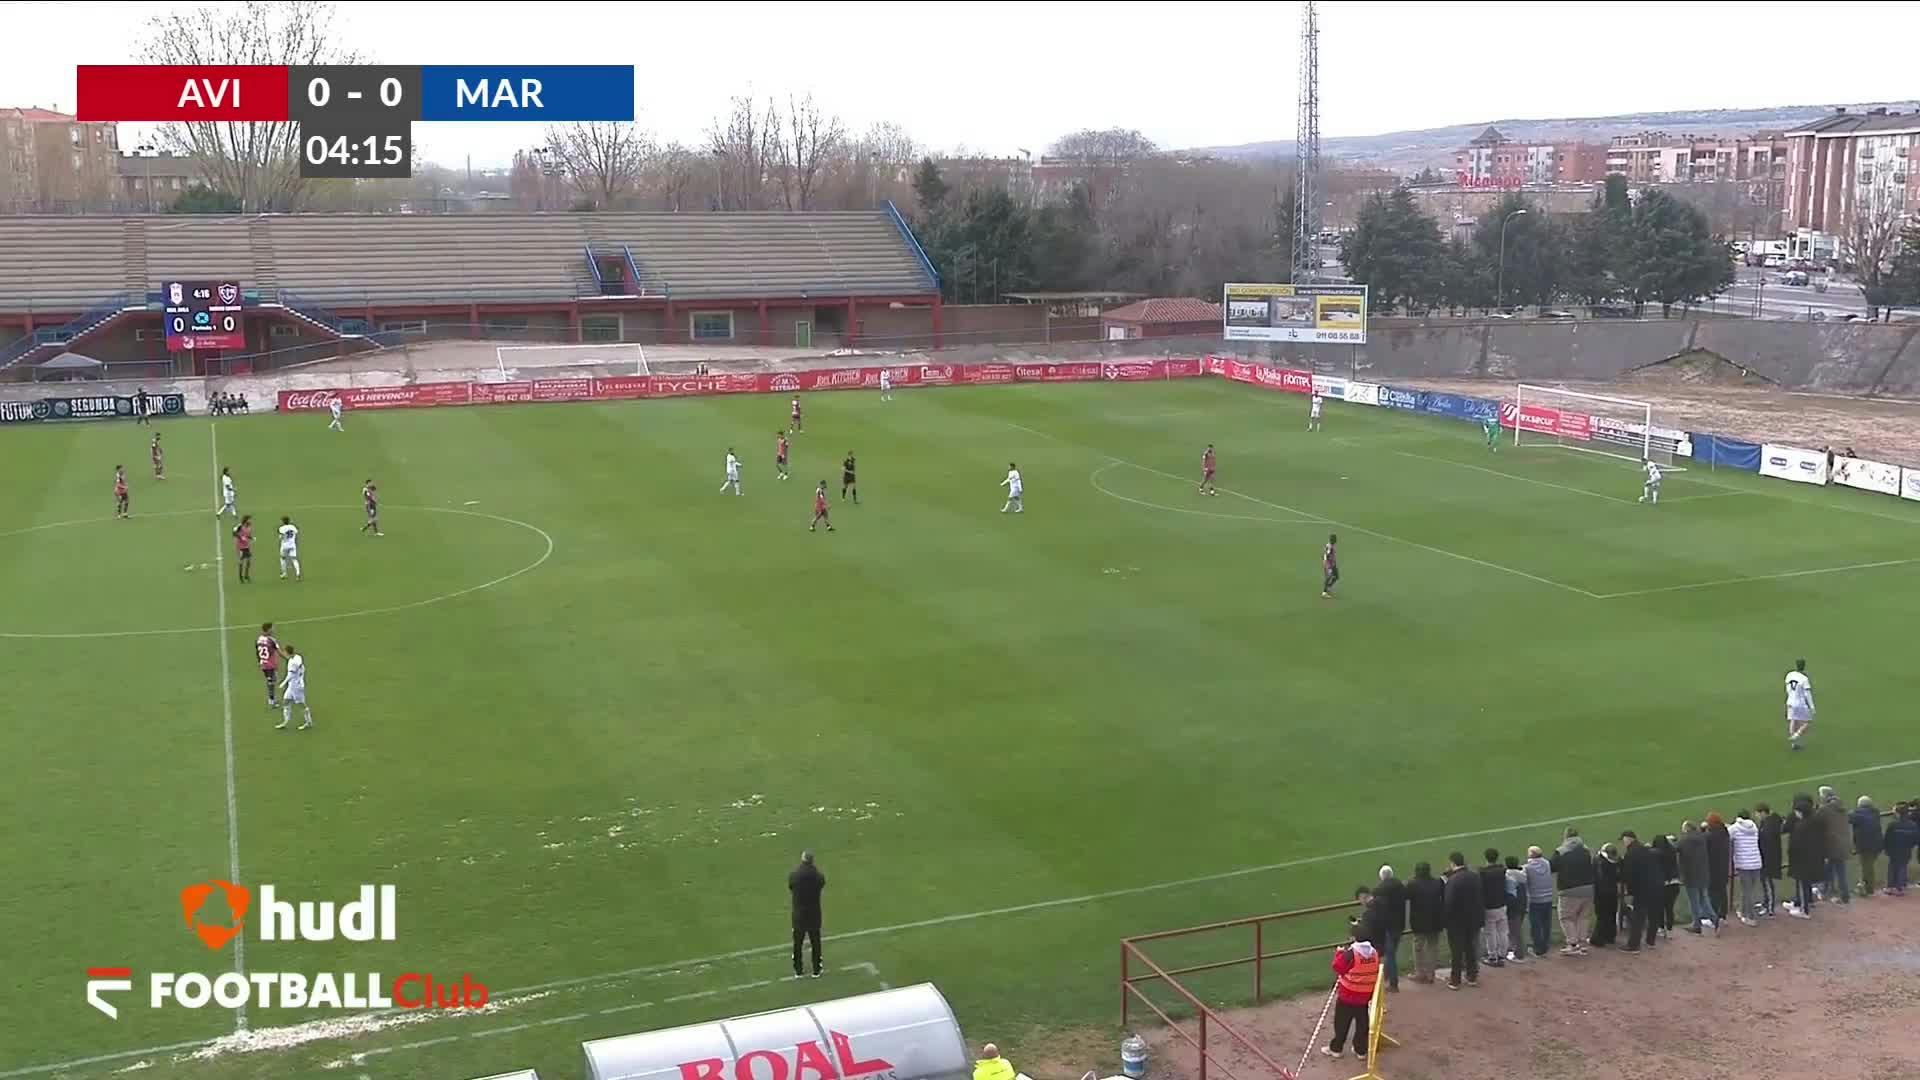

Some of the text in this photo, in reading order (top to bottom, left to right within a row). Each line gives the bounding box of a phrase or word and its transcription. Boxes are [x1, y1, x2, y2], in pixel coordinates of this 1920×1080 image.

[174, 317, 184, 332] 0
[224, 316, 234, 331] 0
[71, 398, 116, 412] SEGUNDA
[258, 646, 270, 660] 23
